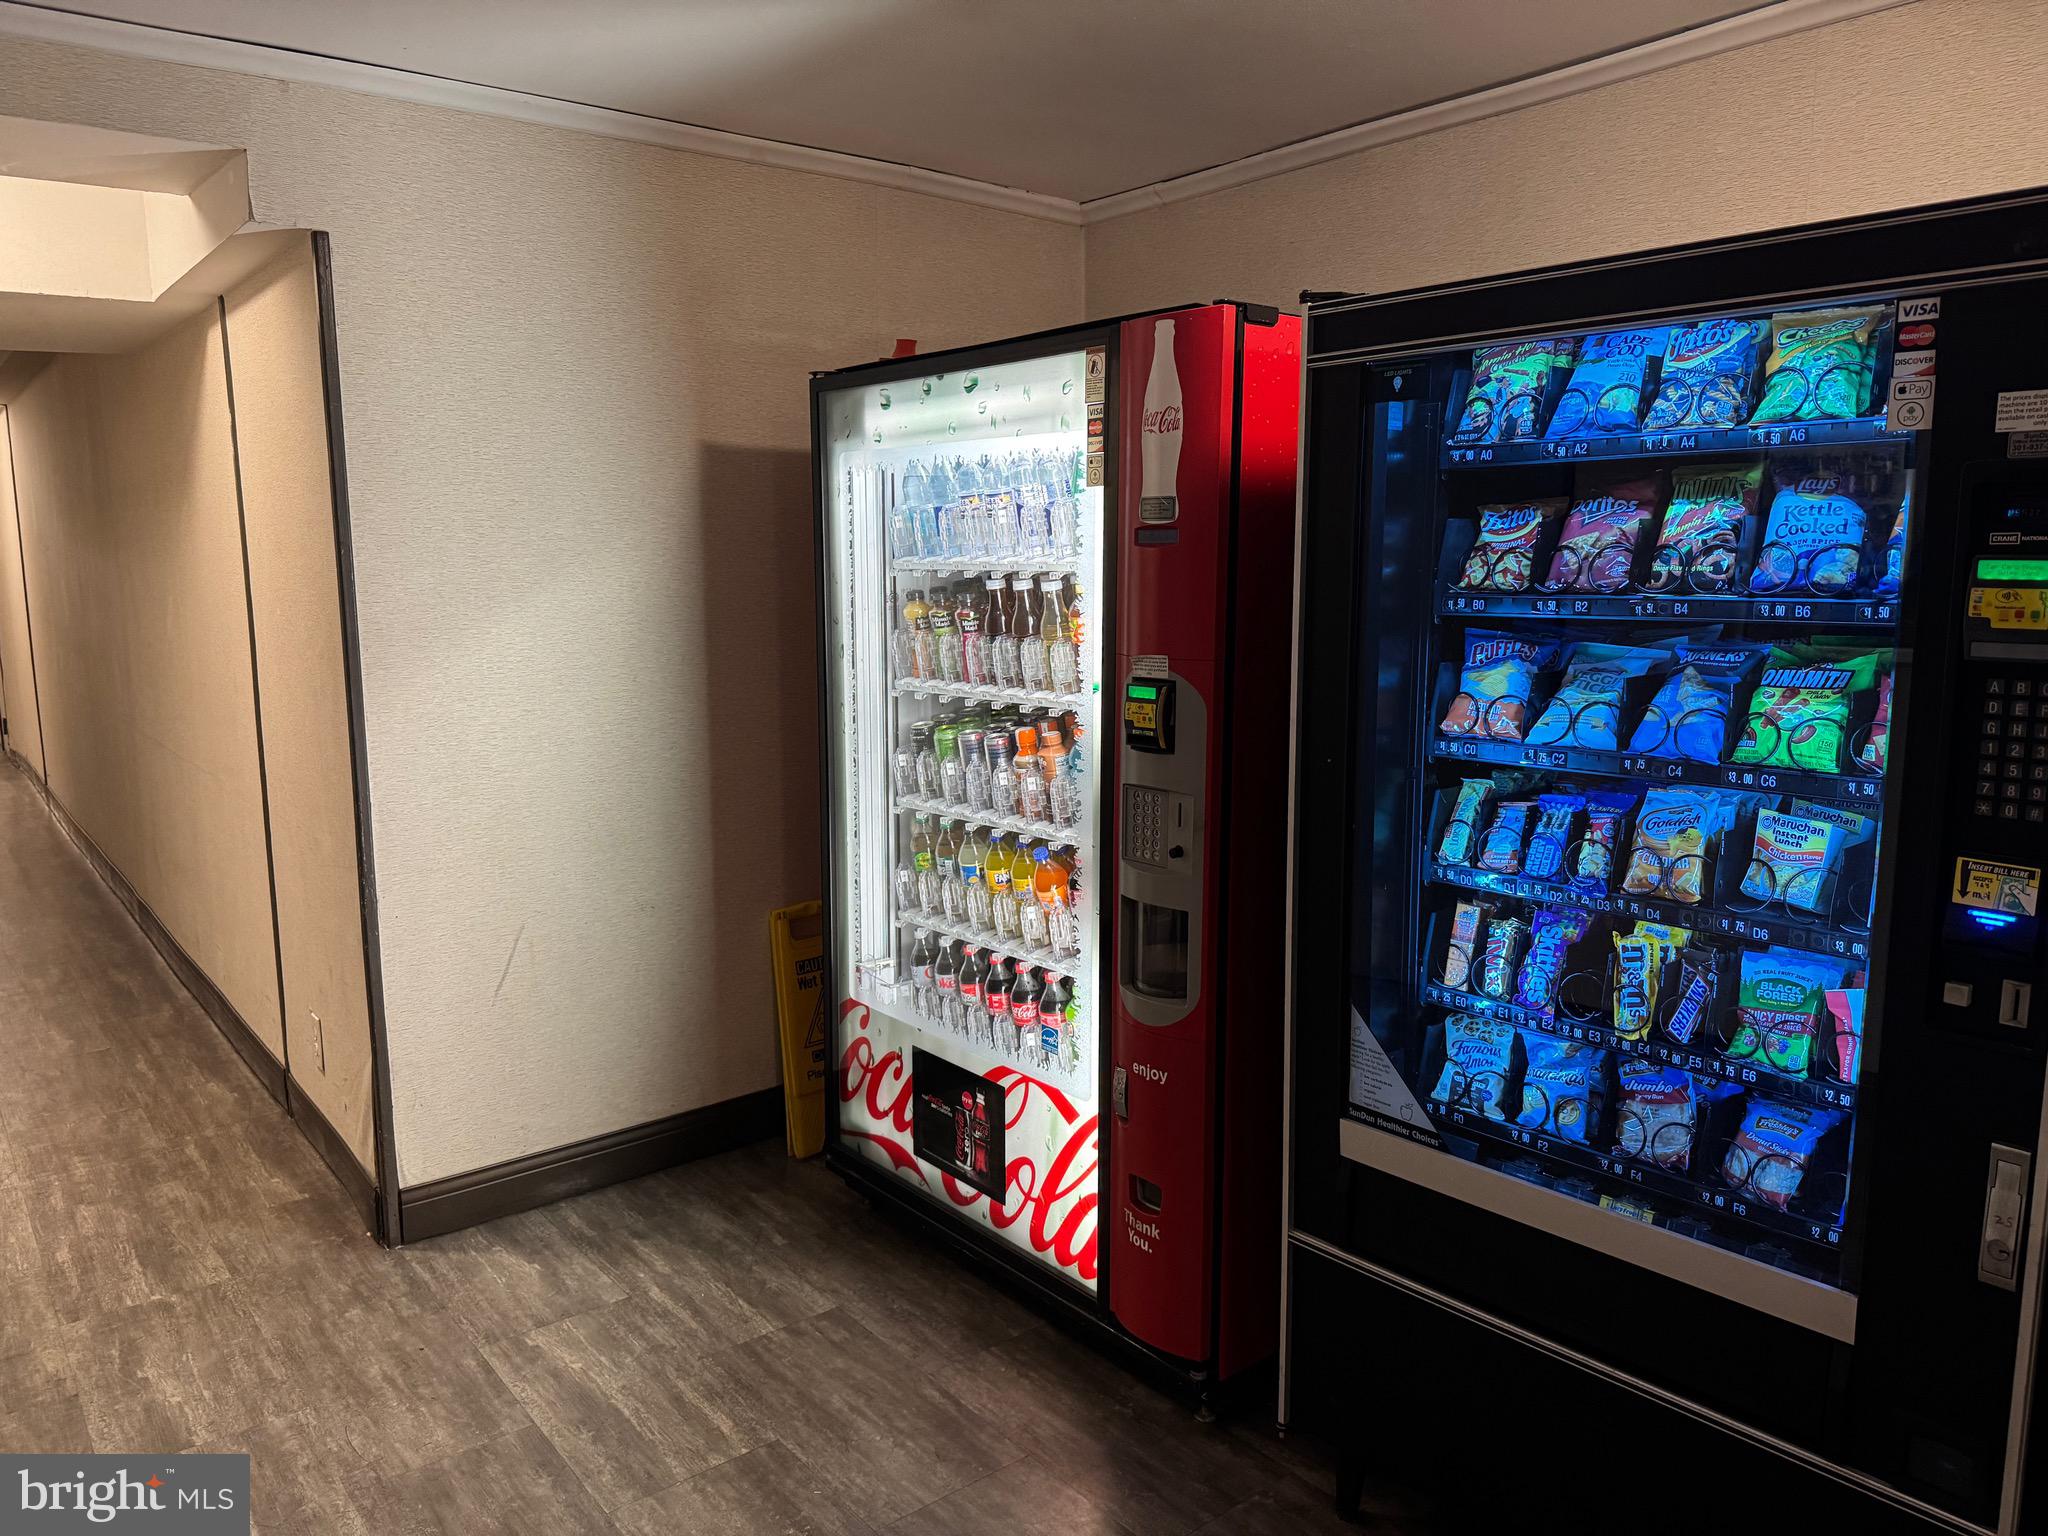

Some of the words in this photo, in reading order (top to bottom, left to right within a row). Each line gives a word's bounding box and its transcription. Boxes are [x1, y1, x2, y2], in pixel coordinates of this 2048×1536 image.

[1902, 302, 1939, 317] VISA
[1606, 335, 1652, 349] CAPE
[1899, 330, 1935, 341] MasterCard
[1605, 345, 1645, 358] COD
[1895, 356, 1935, 366] DISCOVER
[1908, 383, 1929, 396] Pay
[1681, 435, 1695, 448] A4
[1789, 430, 1806, 442] A6
[1574, 443, 1588, 455] A2
[1571, 496, 1641, 516] Doritos
[1784, 502, 1844, 523] Kettle
[1481, 505, 1537, 532] Fritos
[1775, 517, 1849, 540] Cooked
[1472, 600, 1485, 611] B0
[1575, 601, 1588, 612] B2
[1674, 602, 1688, 614] B4
[1760, 603, 1786, 617] $3.00
[1795, 604, 1812, 617] B6
[1470, 638, 1538, 666] RUFFLES
[1760, 669, 1852, 689] DINAMITA
[1990, 681, 1999, 693] A
[2016, 683, 2025, 694] B
[1989, 701, 1998, 713] D
[2015, 703, 2024, 715] E
[1987, 721, 1996, 734] G
[2013, 723, 2022, 736] H
[1464, 744, 1476, 755] C0
[2011, 744, 2020, 756] 2
[2037, 746, 2045, 758] 3
[1551, 752, 1565, 764] C2
[1667, 765, 1682, 777] C4
[1983, 763, 1991, 774] 4
[2009, 765, 2018, 776] 5
[2035, 767, 2043, 778] 6
[1728, 771, 1753, 786] $3.00
[1760, 775, 1777, 788] C6
[1982, 782, 1990, 793] 7
[2007, 785, 2015, 796] 8
[2033, 787, 2041, 799] 9
[1645, 814, 1701, 832] Goldfish
[1804, 805, 1859, 829] Maruchan
[1772, 815, 1827, 838] Maruchan
[1773, 827, 1809, 843] Instant
[1774, 836, 1803, 849] Lunch
[1768, 847, 1803, 861] Chicken
[1968, 861, 1994, 873] INSERT
[1993, 866, 2009, 876] BILL
[2010, 869, 2030, 879] HERE
[1550, 890, 1562, 903] D2
[1597, 899, 1610, 911] D3
[1646, 908, 1660, 921] D4
[1721, 918, 1745, 934] $1.75
[1753, 927, 1768, 941] D6
[1835, 941, 1863, 956] $3.00
[797, 976, 818, 990] Wet
[1760, 981, 1801, 994] BLACK
[1455, 996, 1467, 1008] E0
[1756, 989, 1804, 1003] FOREST
[1498, 1007, 1509, 1019] E1
[1541, 1018, 1554, 1030] E2
[1588, 1030, 1601, 1043] E3
[1451, 1039, 1501, 1057] Famous
[1637, 1043, 1650, 1055] E4
[1460, 1055, 1497, 1070] Amos
[1659, 1049, 1681, 1065] $2.00
[1689, 1055, 1702, 1069] E5
[1132, 1061, 1168, 1085] enjoy
[1712, 1060, 1735, 1077] $1.75
[1742, 1069, 1757, 1083] E6
[1624, 1079, 1676, 1093] Jumbo
[1824, 1089, 1850, 1106] $2.50
[1349, 1107, 1375, 1124] SunDun
[1377, 1117, 1411, 1137] Healthier
[1453, 1113, 1464, 1125] F0
[1758, 1119, 1799, 1137] Freshley's
[1746, 1131, 1772, 1149] Donut
[1537, 1142, 1549, 1153] F2
[1601, 1158, 1623, 1175] $2.00
[1630, 1170, 1642, 1183] F4
[1702, 1191, 1725, 1207] $2.00
[1733, 1202, 1747, 1216] F6
[1124, 1208, 1161, 1241] Thank
[1128, 1229, 1153, 1254] You.
[1811, 1226, 1839, 1244] $2.00
